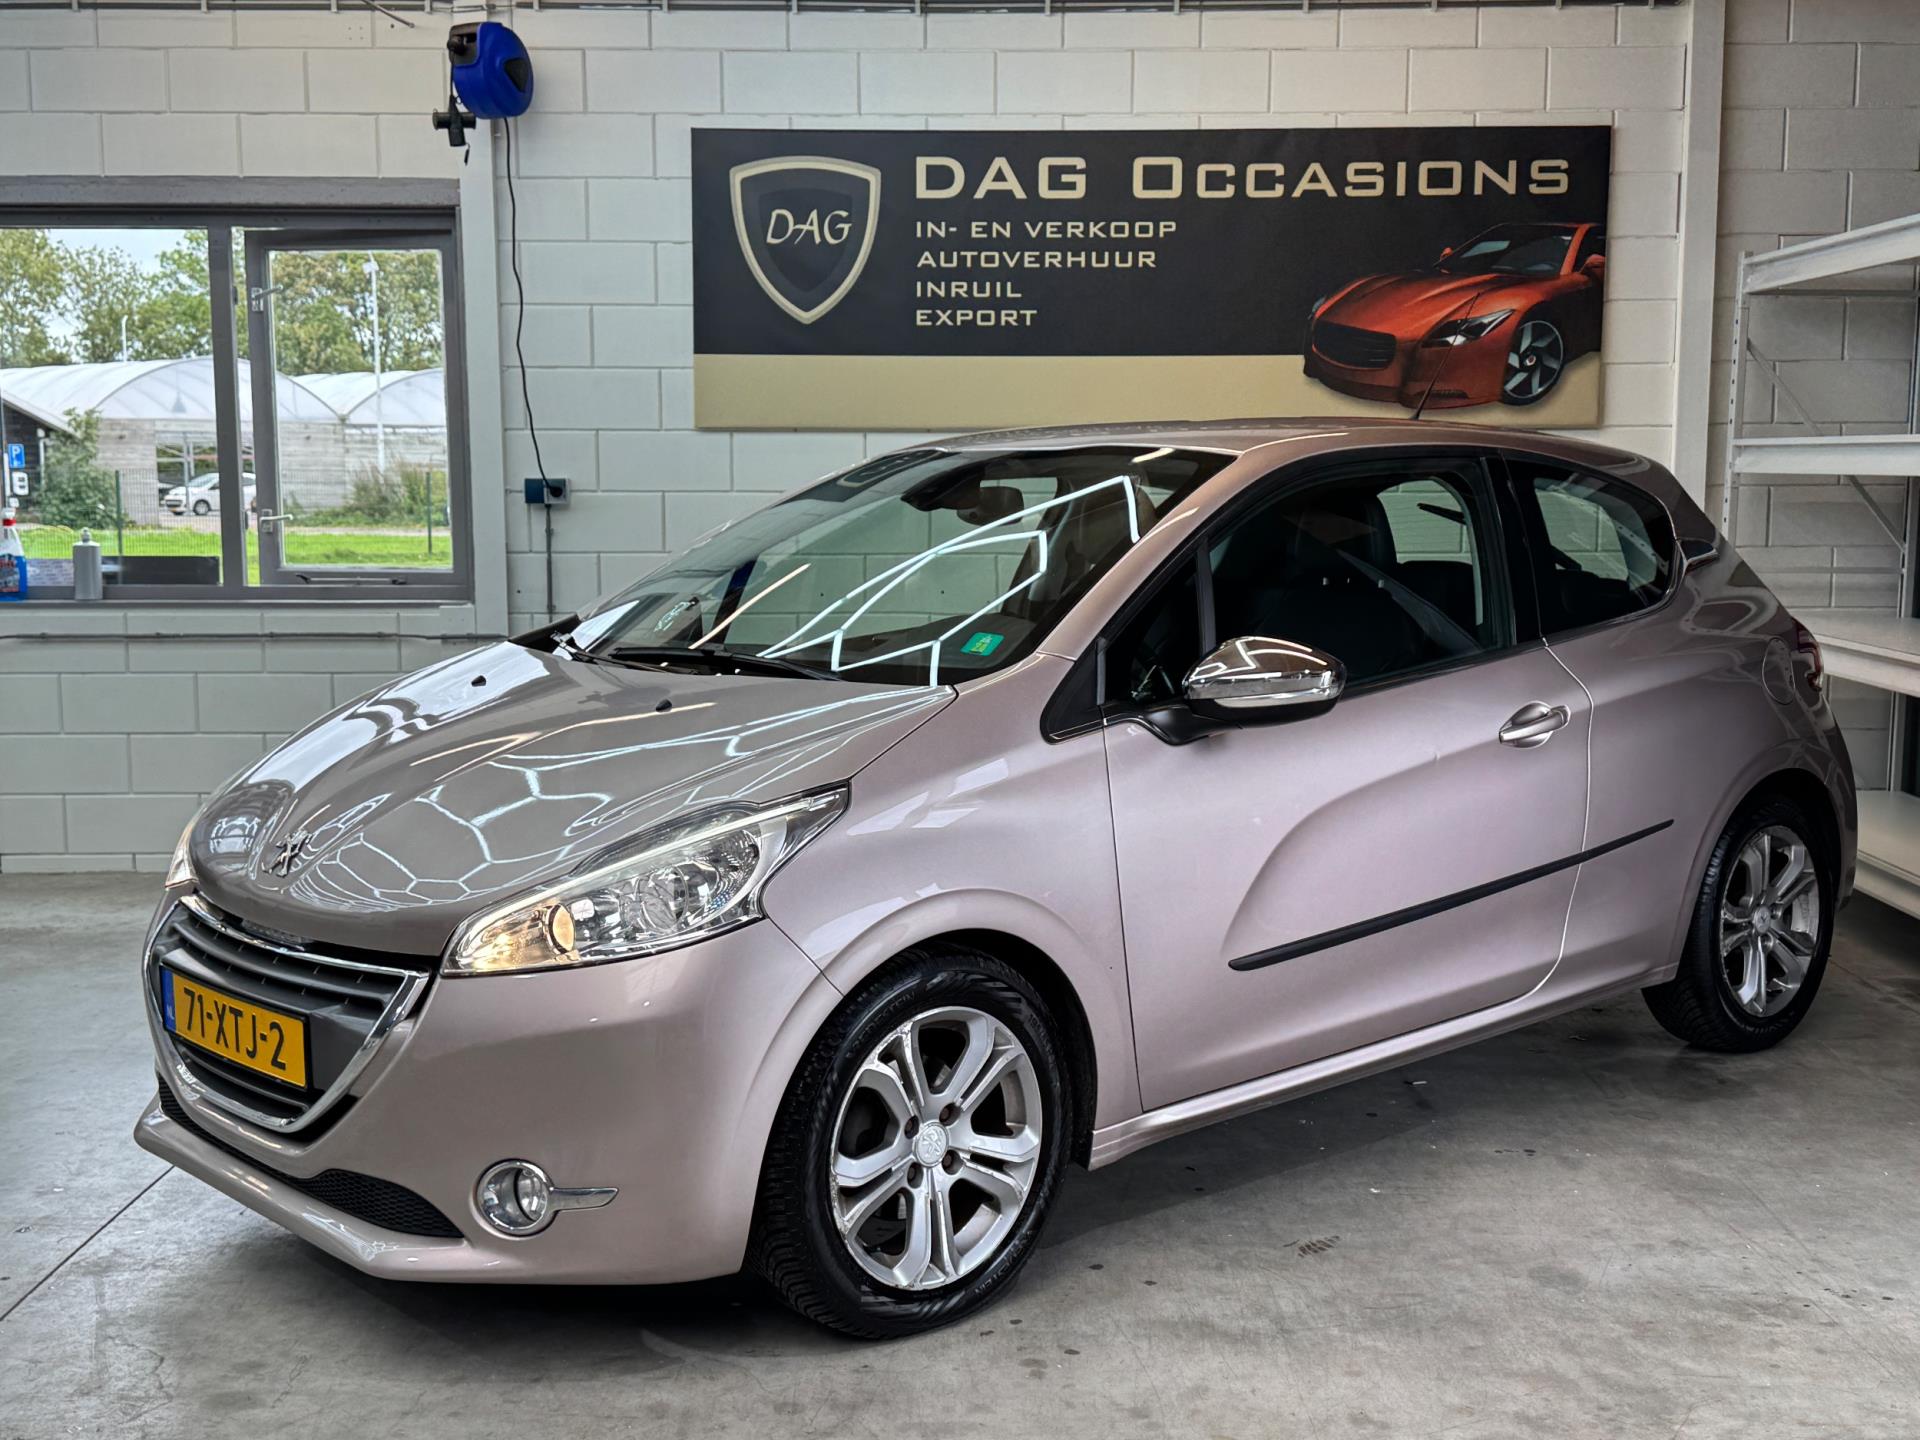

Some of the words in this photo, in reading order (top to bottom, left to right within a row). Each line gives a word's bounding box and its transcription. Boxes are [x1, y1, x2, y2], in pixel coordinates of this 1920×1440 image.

[915, 155, 1088, 200] DAG
[1132, 156, 1569, 199] OCCASIONS
[766, 207, 853, 246] DAG
[916, 221, 958, 239] IN-
[970, 221, 1011, 239] EN
[1024, 221, 1178, 239] VERKOOP
[916, 250, 1157, 268] AUTOVERHUUR
[915, 280, 1022, 298] INRUIL
[915, 309, 1038, 327] EXPORT
[183, 986, 287, 1072] 71-XTJ-2
